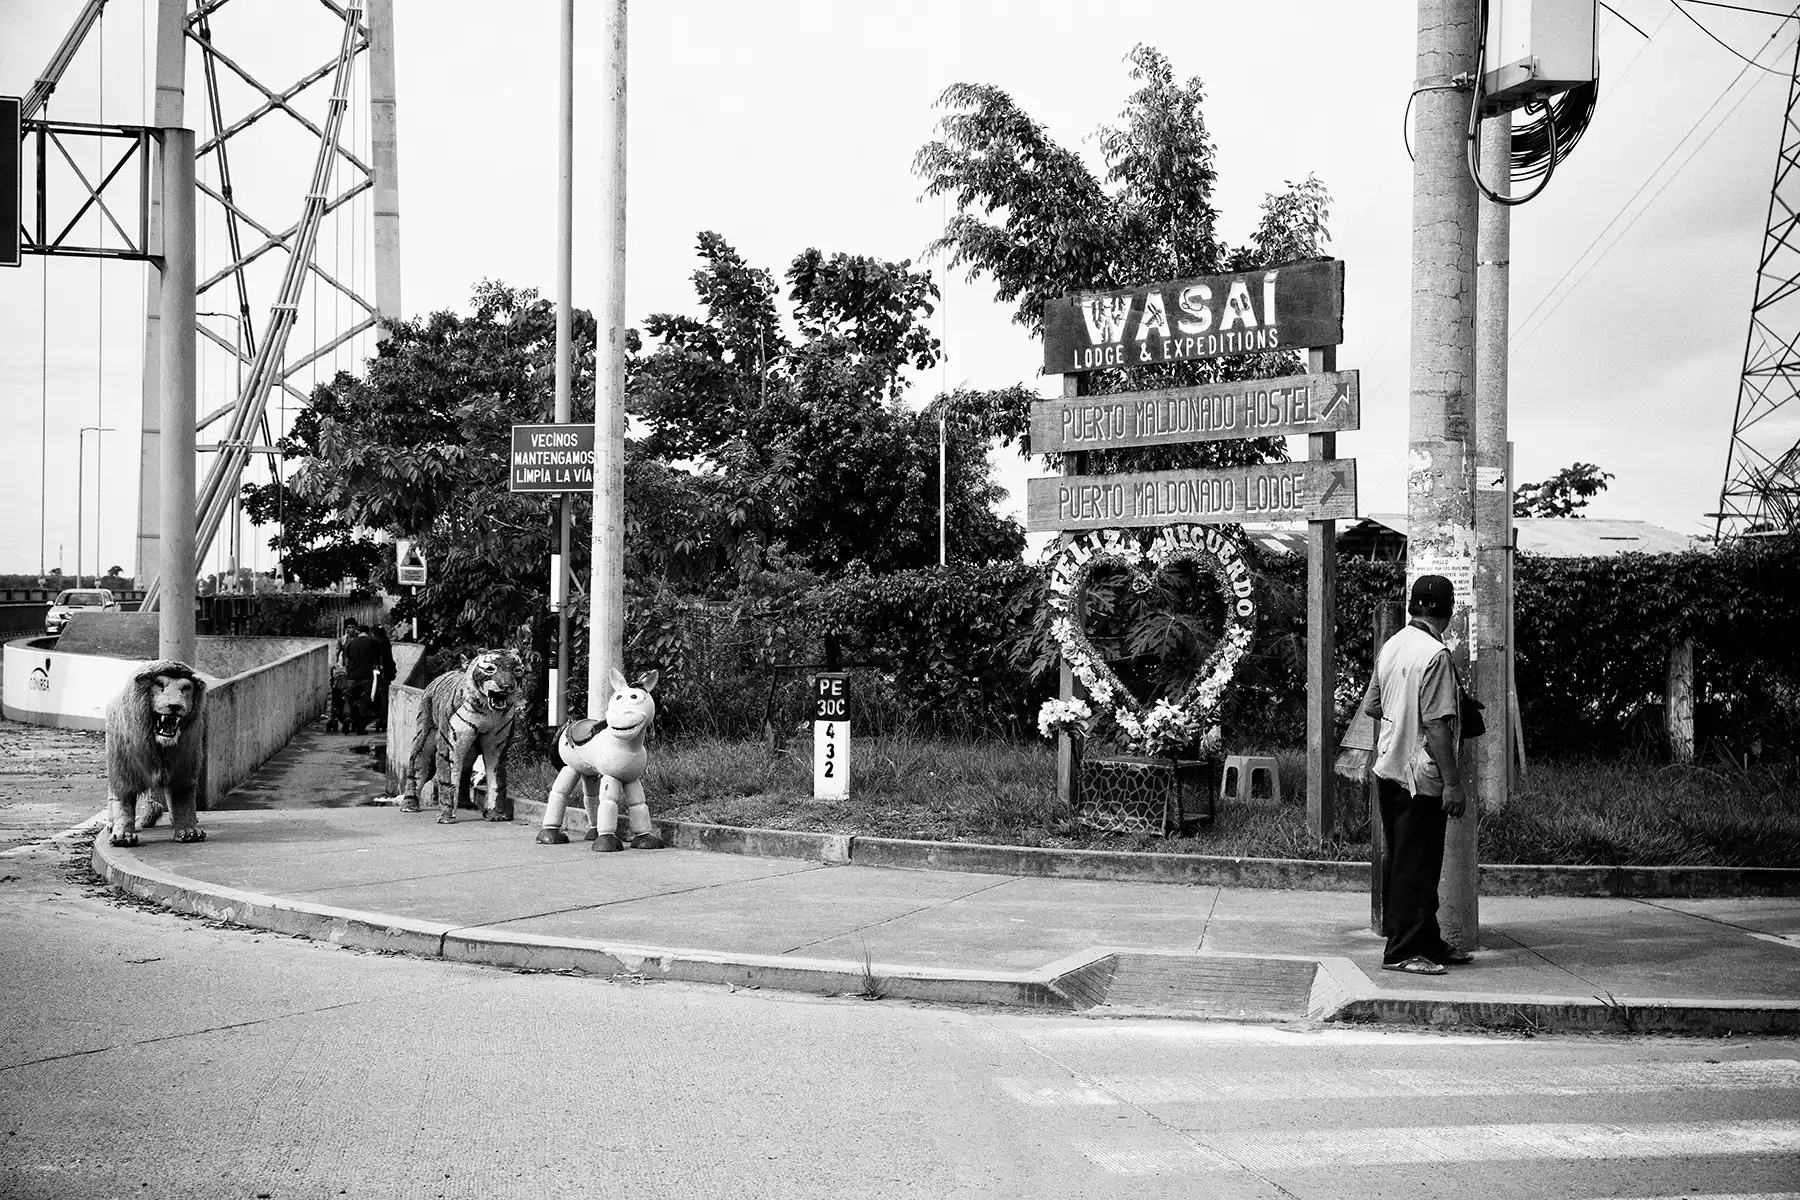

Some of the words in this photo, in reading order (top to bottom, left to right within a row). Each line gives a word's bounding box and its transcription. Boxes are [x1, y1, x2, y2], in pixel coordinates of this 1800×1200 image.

[1074, 345, 1124, 369] LODGE
[1139, 342, 1153, 361] &
[1163, 328, 1279, 360] EXPEDITIONS
[1062, 404, 1126, 444] PUERTO
[1135, 393, 1237, 437] MALDONADO
[1245, 386, 1318, 428] HOSTEL
[531, 432, 579, 448] VECINOS
[514, 451, 595, 466] MANTENGAMOS
[516, 467, 551, 483] LIMPIA
[556, 469, 571, 483] LA
[1059, 483, 1125, 522] PUERTO
[1133, 477, 1236, 519] MALDONADO
[1245, 472, 1305, 513] LODGE
[1162, 524, 1254, 618] RECUERDO
[820, 679, 843, 696] PE
[817, 698, 845, 716] 30C
